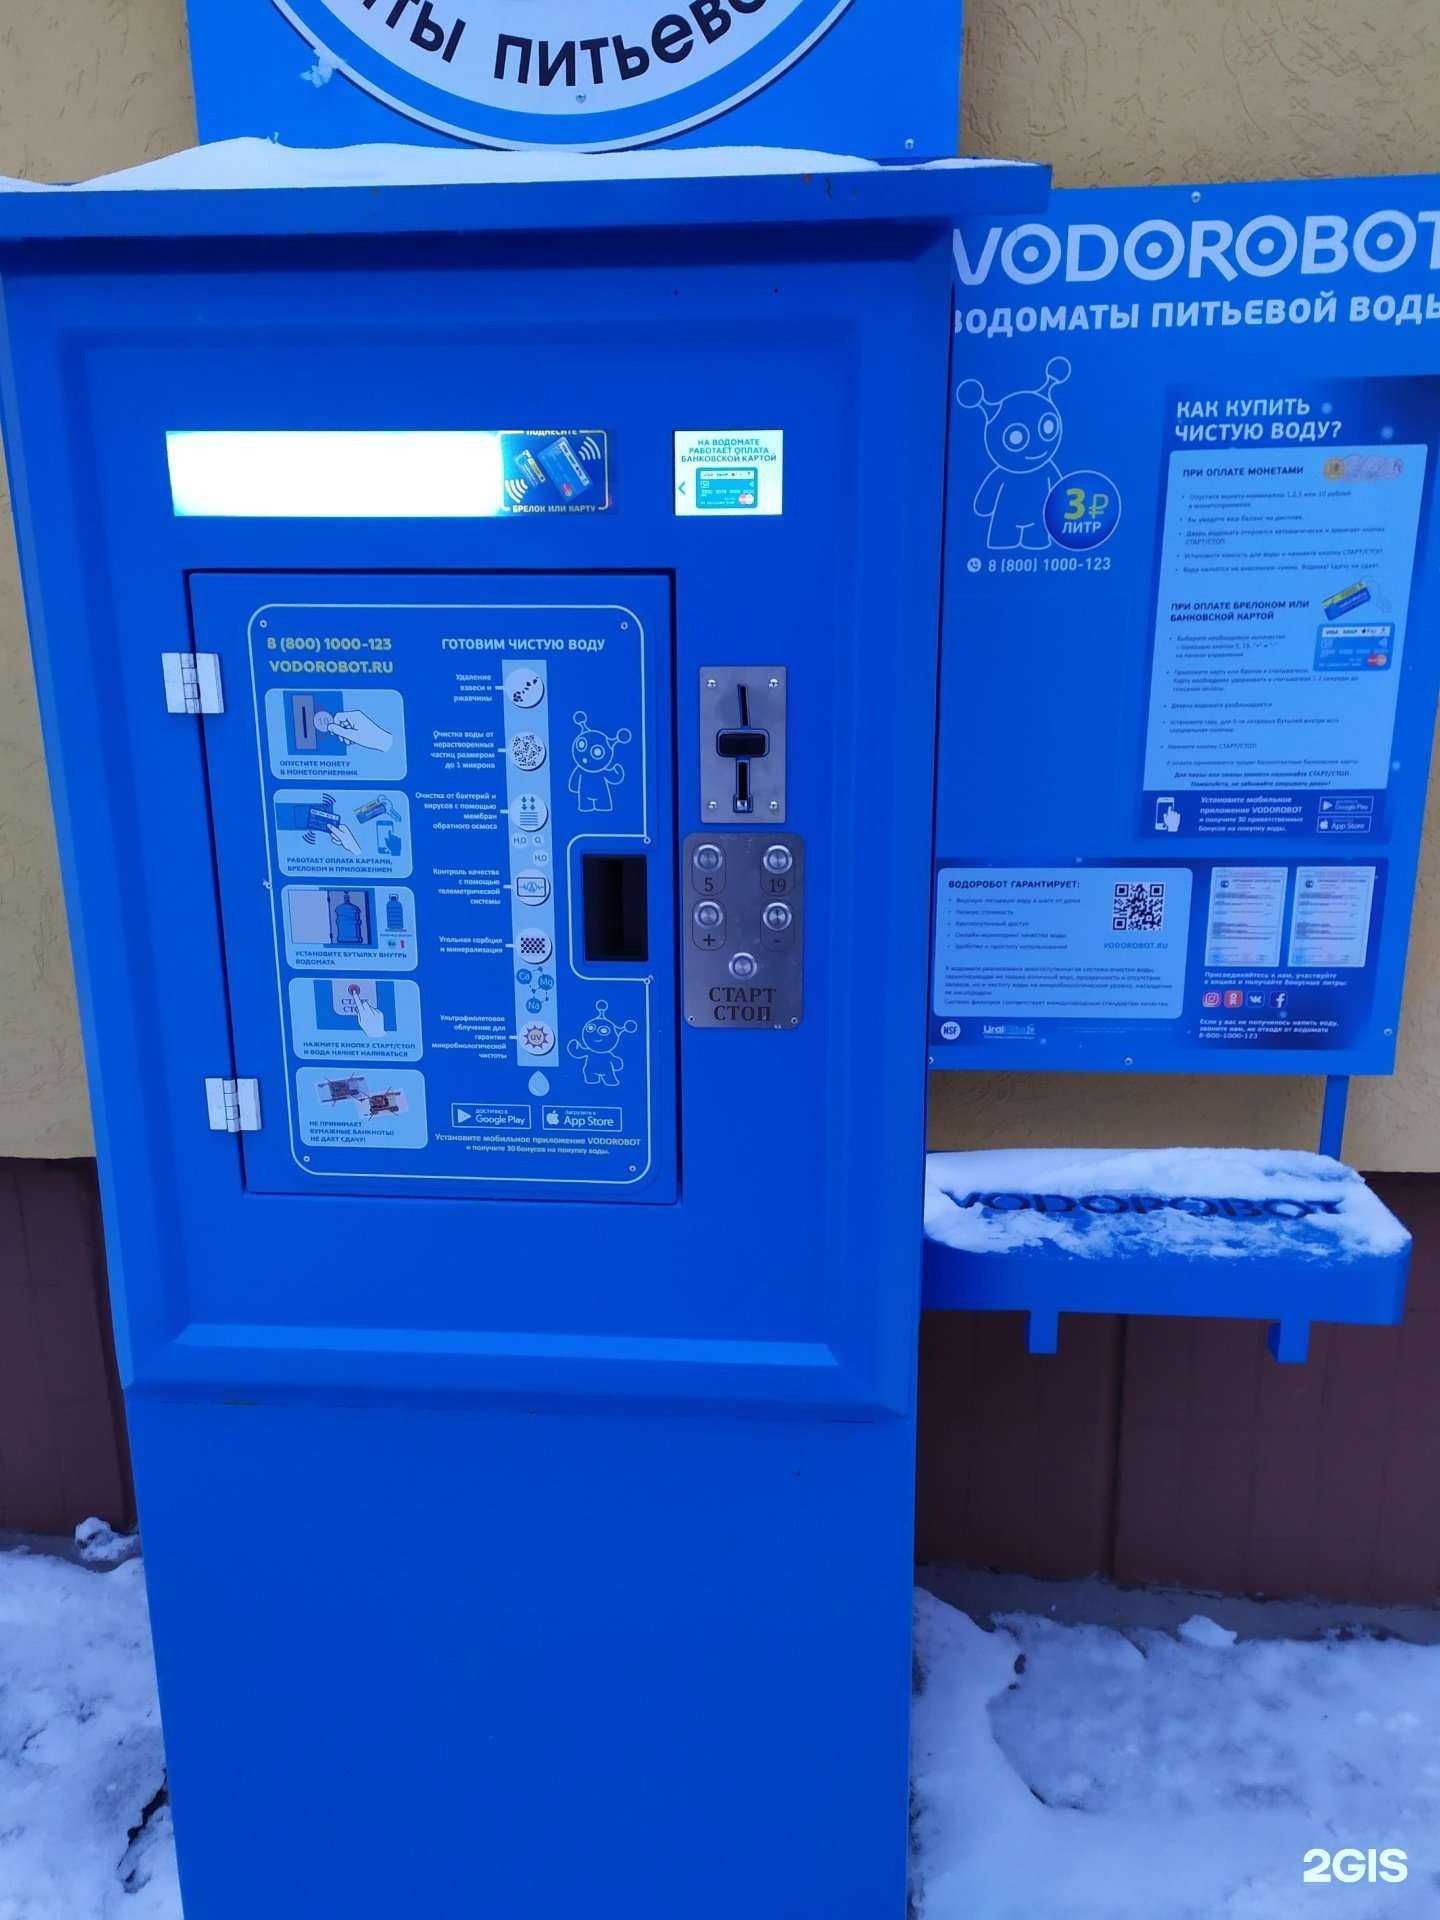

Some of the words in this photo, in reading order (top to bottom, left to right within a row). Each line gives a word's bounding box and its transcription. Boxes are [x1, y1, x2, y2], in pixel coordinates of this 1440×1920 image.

[1152, 290, 1337, 328] ПИТЬЕВОЙ
[1177, 401, 1218, 418] КАК
[1226, 398, 1310, 417] КУПИТЬ
[1175, 424, 1263, 441] ЧИСТУЮ
[1271, 421, 1342, 441] ВОДУ?
[681, 454, 740, 462] БАНКОВСКОЙ
[742, 454, 777, 462] КАРТОЙ
[1183, 468, 1203, 477] ПРИ
[1206, 467, 1245, 476] ОПЛАТЕ
[1248, 466, 1304, 475] МОНЕТАМИ
[513, 504, 546, 513] БРЕЛОК
[569, 505, 596, 513] КАРТУ
[1062, 522, 1101, 534] ЛИТР
[988, 559, 996, 572] 8
[1001, 558, 1037, 572] (800)
[1043, 557, 1111, 571] 1000-123
[1171, 602, 1191, 611] ПРИ
[1194, 602, 1231, 611] ОПЛАТЕ
[1233, 601, 1286, 610] БРЕЛОКОМ
[1289, 600, 1309, 609] ИЛИ
[1170, 611, 1234, 622] БАНКОВСКОЙ
[1237, 611, 1274, 621] КАРТОЙ
[267, 638, 276, 650] 8
[281, 638, 320, 652] (800)
[324, 638, 392, 650] 1000-123
[442, 639, 504, 650] ГОТОВИМ
[509, 639, 564, 650] ЧИСТУЮ
[569, 639, 605, 652] ВОДУ
[269, 660, 393, 674] VODOROBOT.RU
[456, 674, 491, 682] Удаление
[454, 695, 492, 703] ржавчины
[433, 731, 462, 739] Очистка
[456, 752, 495, 760] размером
[456, 792, 489, 800] бактерий
[1252, 806, 1303, 814] VODOROBOT
[704, 878, 713, 892] 5
[769, 879, 786, 892] 19
[949, 880, 1008, 889] ВОДОРОБОТ
[1011, 880, 1080, 889] ГАРАНТИРУЕТ:
[439, 936, 472, 944] Угольная
[474, 937, 502, 946] сорбция
[1104, 942, 1168, 950] VODOROBOT.RU
[709, 987, 776, 1003] СТАРТ
[528, 1001, 540, 1011] Na
[714, 1006, 771, 1021] СТОП
[454, 1024, 491, 1032] облучение
[943, 1025, 958, 1036] NSF
[530, 1033, 541, 1041] UV
[479, 1052, 507, 1060] чистоты
[475, 1115, 506, 1125] Google
[508, 1116, 525, 1125] Play
[564, 1116, 585, 1127] App
[587, 1118, 615, 1126] Store
[435, 1134, 481, 1142] Установите
[484, 1135, 530, 1143] мобильное
[533, 1137, 585, 1145] приложение
[587, 1138, 640, 1146] VODOROBOT
